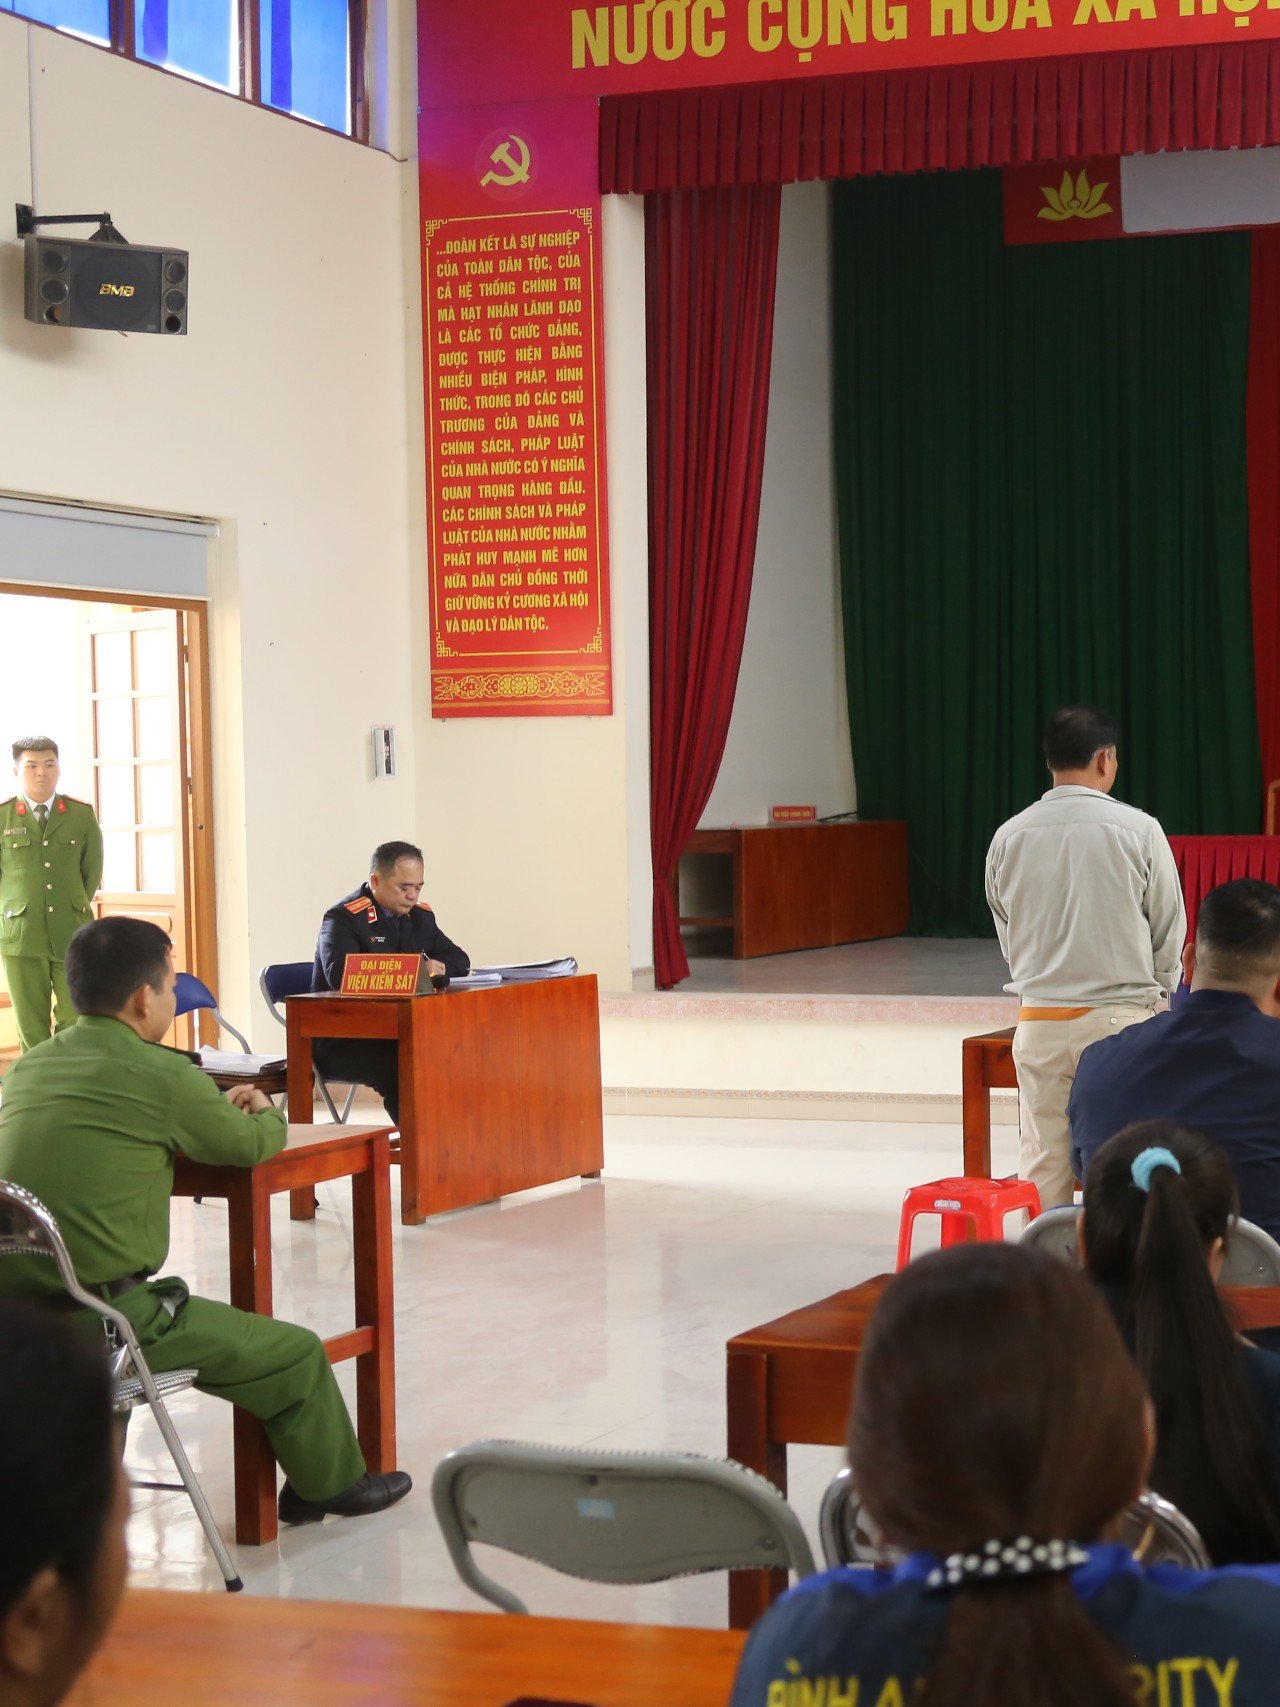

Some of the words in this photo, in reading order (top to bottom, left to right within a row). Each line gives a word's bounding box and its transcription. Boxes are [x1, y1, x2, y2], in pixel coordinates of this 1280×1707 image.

[480, 234, 499, 251] KẾT
[503, 234, 516, 249] LÀ
[521, 234, 536, 250] SỰ
[539, 230, 580, 248] NGHIỆP
[437, 260, 458, 277] CỦA
[465, 259, 493, 275] TOÀN
[499, 257, 521, 272] DÂN
[528, 254, 552, 273] TỘC,
[558, 250, 580, 268] CỦA
[99, 283, 135, 297] BMB
[438, 282, 451, 299] CẢ
[459, 282, 472, 300] HỆ
[523, 277, 556, 293] CHÍNH
[563, 277, 580, 293] TRỊ
[438, 306, 455, 321] MÀ
[461, 306, 481, 322] HẠT
[488, 302, 518, 318] NHÂN
[524, 300, 553, 316] LÃNH
[559, 299, 581, 316] ĐẠO
[438, 329, 451, 344] LÀ
[459, 326, 481, 343] CÁC
[489, 322, 502, 341] TỔ
[510, 323, 539, 339] CHỨC
[548, 319, 582, 337] ĐẢNG,
[439, 351, 468, 368] ĐƯỢC
[478, 349, 505, 366] THỰC
[516, 345, 541, 363] HIỆN
[481, 370, 507, 388] BIỆN
[516, 367, 547, 384] PHÁP,
[556, 366, 582, 382] HÌNH
[440, 395, 470, 411] THỨC,
[475, 394, 511, 409] TRONG
[515, 391, 530, 407] ĐÓ
[535, 389, 556, 405] CÁC
[561, 386, 583, 404] CHỦ
[440, 418, 484, 433] TRƯƠNG
[495, 412, 517, 430] CỦA
[528, 411, 559, 428] ĐẢNG
[570, 410, 584, 426] VÀ
[441, 439, 474, 455] CHÍNH
[482, 437, 514, 453] SÁCH,
[521, 435, 550, 451] PHÁP
[558, 433, 584, 451] LUẬT
[442, 460, 463, 477] CỦA
[466, 460, 488, 476] NHÀ
[491, 458, 521, 475] NƯỚC
[524, 458, 538, 473] CÓ
[541, 457, 548, 472] Ý
[551, 456, 585, 472] NGHĨA
[442, 486, 471, 501] QUAN
[478, 484, 514, 500] TRỌNG
[522, 480, 552, 496] HÀNG
[443, 506, 464, 522] CÁC
[468, 505, 501, 521] CHÍNH
[506, 503, 534, 519] SÁCH
[538, 502, 552, 518] VÀ
[556, 501, 586, 517] PHÁP
[443, 528, 469, 546] LUẬT
[472, 525, 493, 543] CỦA
[496, 526, 518, 542] NHÀ
[521, 524, 550, 541] NƯỚC
[553, 521, 586, 539] NHẰM
[444, 550, 471, 566] PHÁT
[477, 551, 497, 565] HUY
[503, 550, 536, 566] MẠNH
[564, 547, 587, 561] HƠN
[445, 573, 467, 588] NỮA
[472, 572, 495, 587] DÂN
[500, 569, 522, 586] CHỦ
[563, 567, 587, 584] THỜI
[445, 595, 466, 611] GIỮ
[466, 594, 494, 610] VỮNG
[497, 591, 510, 609] KỶ
[513, 593, 550, 608] CƯƠNG
[553, 592, 567, 607] XÃ
[570, 591, 588, 609] HỘI
[446, 617, 459, 633] VÀ
[462, 619, 483, 635] ĐẠO
[486, 616, 497, 631] LÝ
[500, 615, 522, 631] DÂN
[524, 614, 548, 633] TỘC.
[347, 971, 368, 992] VIỆN
[369, 969, 394, 990] KIỂM
[395, 971, 414, 990] SÁT
